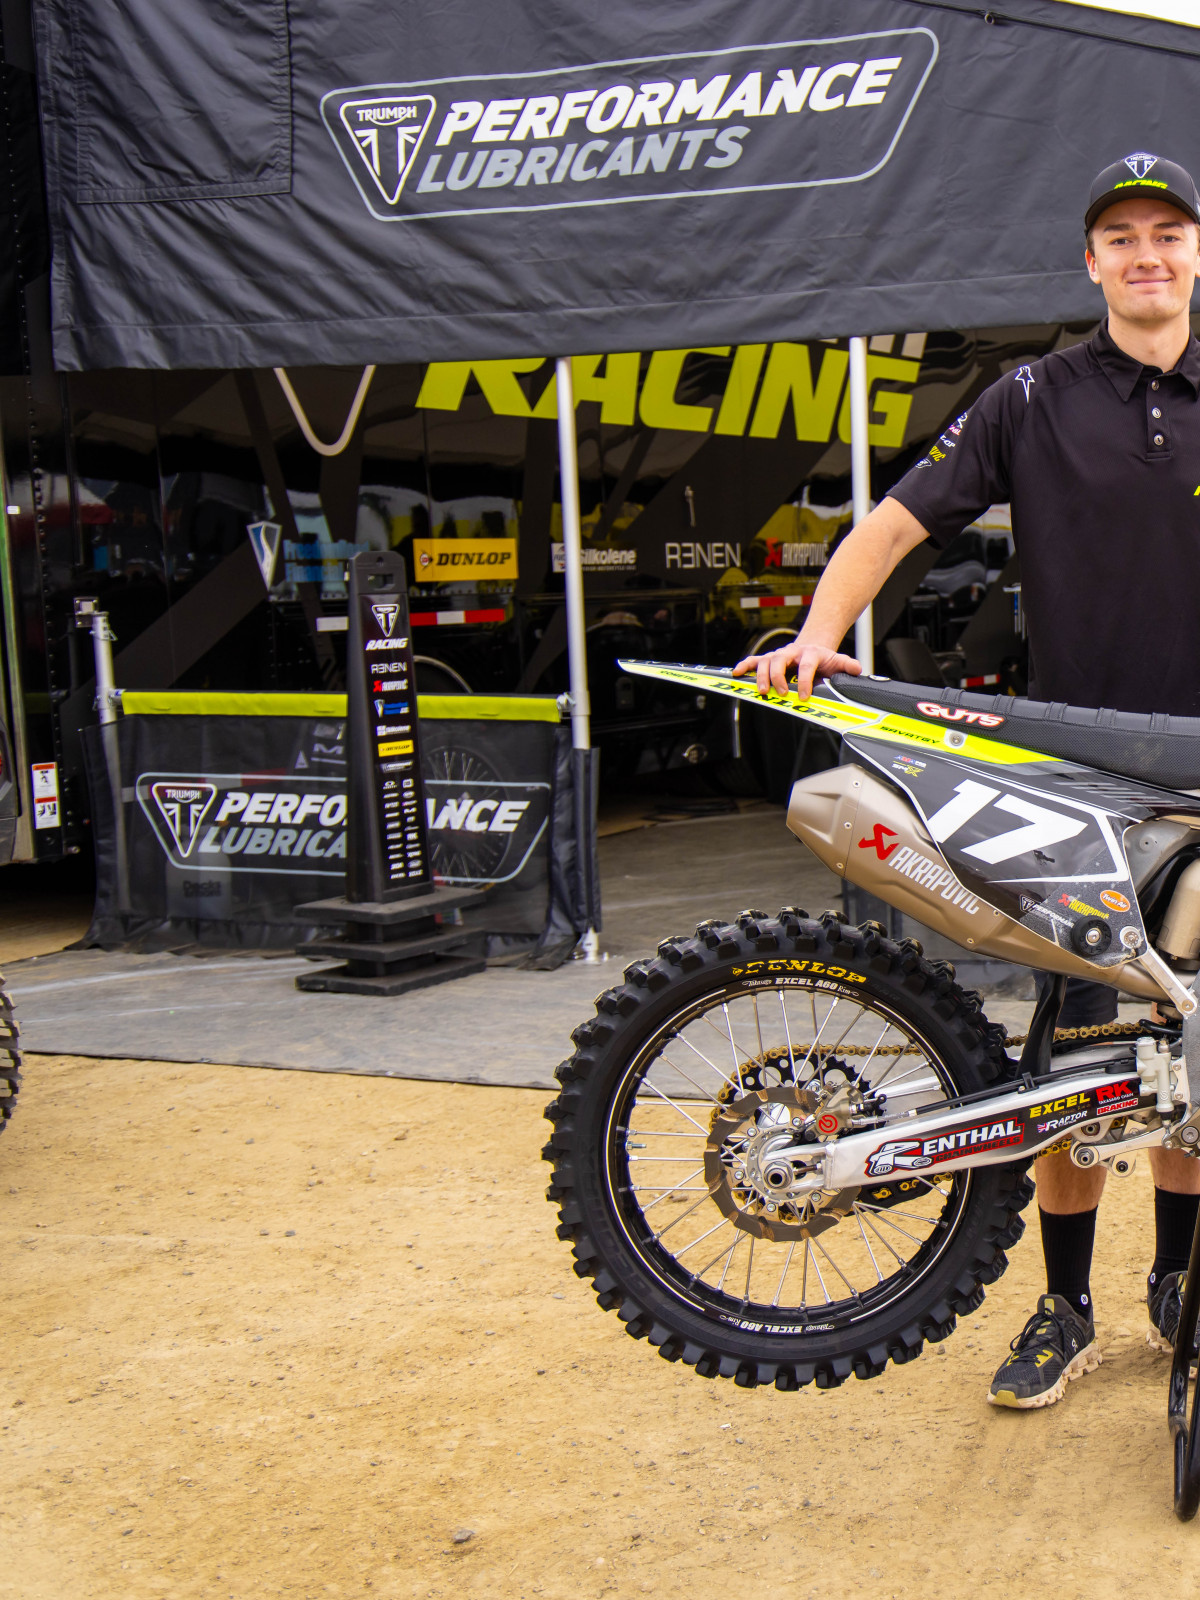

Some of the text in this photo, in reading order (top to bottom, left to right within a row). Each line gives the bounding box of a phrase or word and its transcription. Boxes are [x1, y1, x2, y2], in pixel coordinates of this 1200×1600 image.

[435, 57, 902, 146] PERFORMANCE
[357, 105, 417, 124] TRIUMPH
[416, 126, 751, 194] LUBRICANTS
[415, 342, 920, 448] RACING
[436, 551, 511, 567] DUNLOP
[365, 637, 409, 651] RACING
[709, 681, 838, 720] DUNLOP
[916, 701, 1004, 727] GUTS
[880, 726, 940, 744] SAVATGY
[165, 789, 201, 800] TRIUMPH
[215, 791, 531, 832] PERFONCE
[927, 778, 1089, 865] 17
[198, 826, 347, 860] LUBRICA
[1102, 893, 1128, 909] Twin Air
[775, 977, 814, 987] EXCEL
[815, 979, 838, 990] A60
[1095, 1080, 1133, 1103] RK
[1029, 1092, 1091, 1119] EXCEL
[1097, 1098, 1138, 1115] BRAKING
[1045, 1110, 1088, 1131] RAPTOR
[935, 1135, 1022, 1162] CHAINWHEELS
[740, 1320, 763, 1332] A60
[764, 1324, 803, 1334] EXCEL
